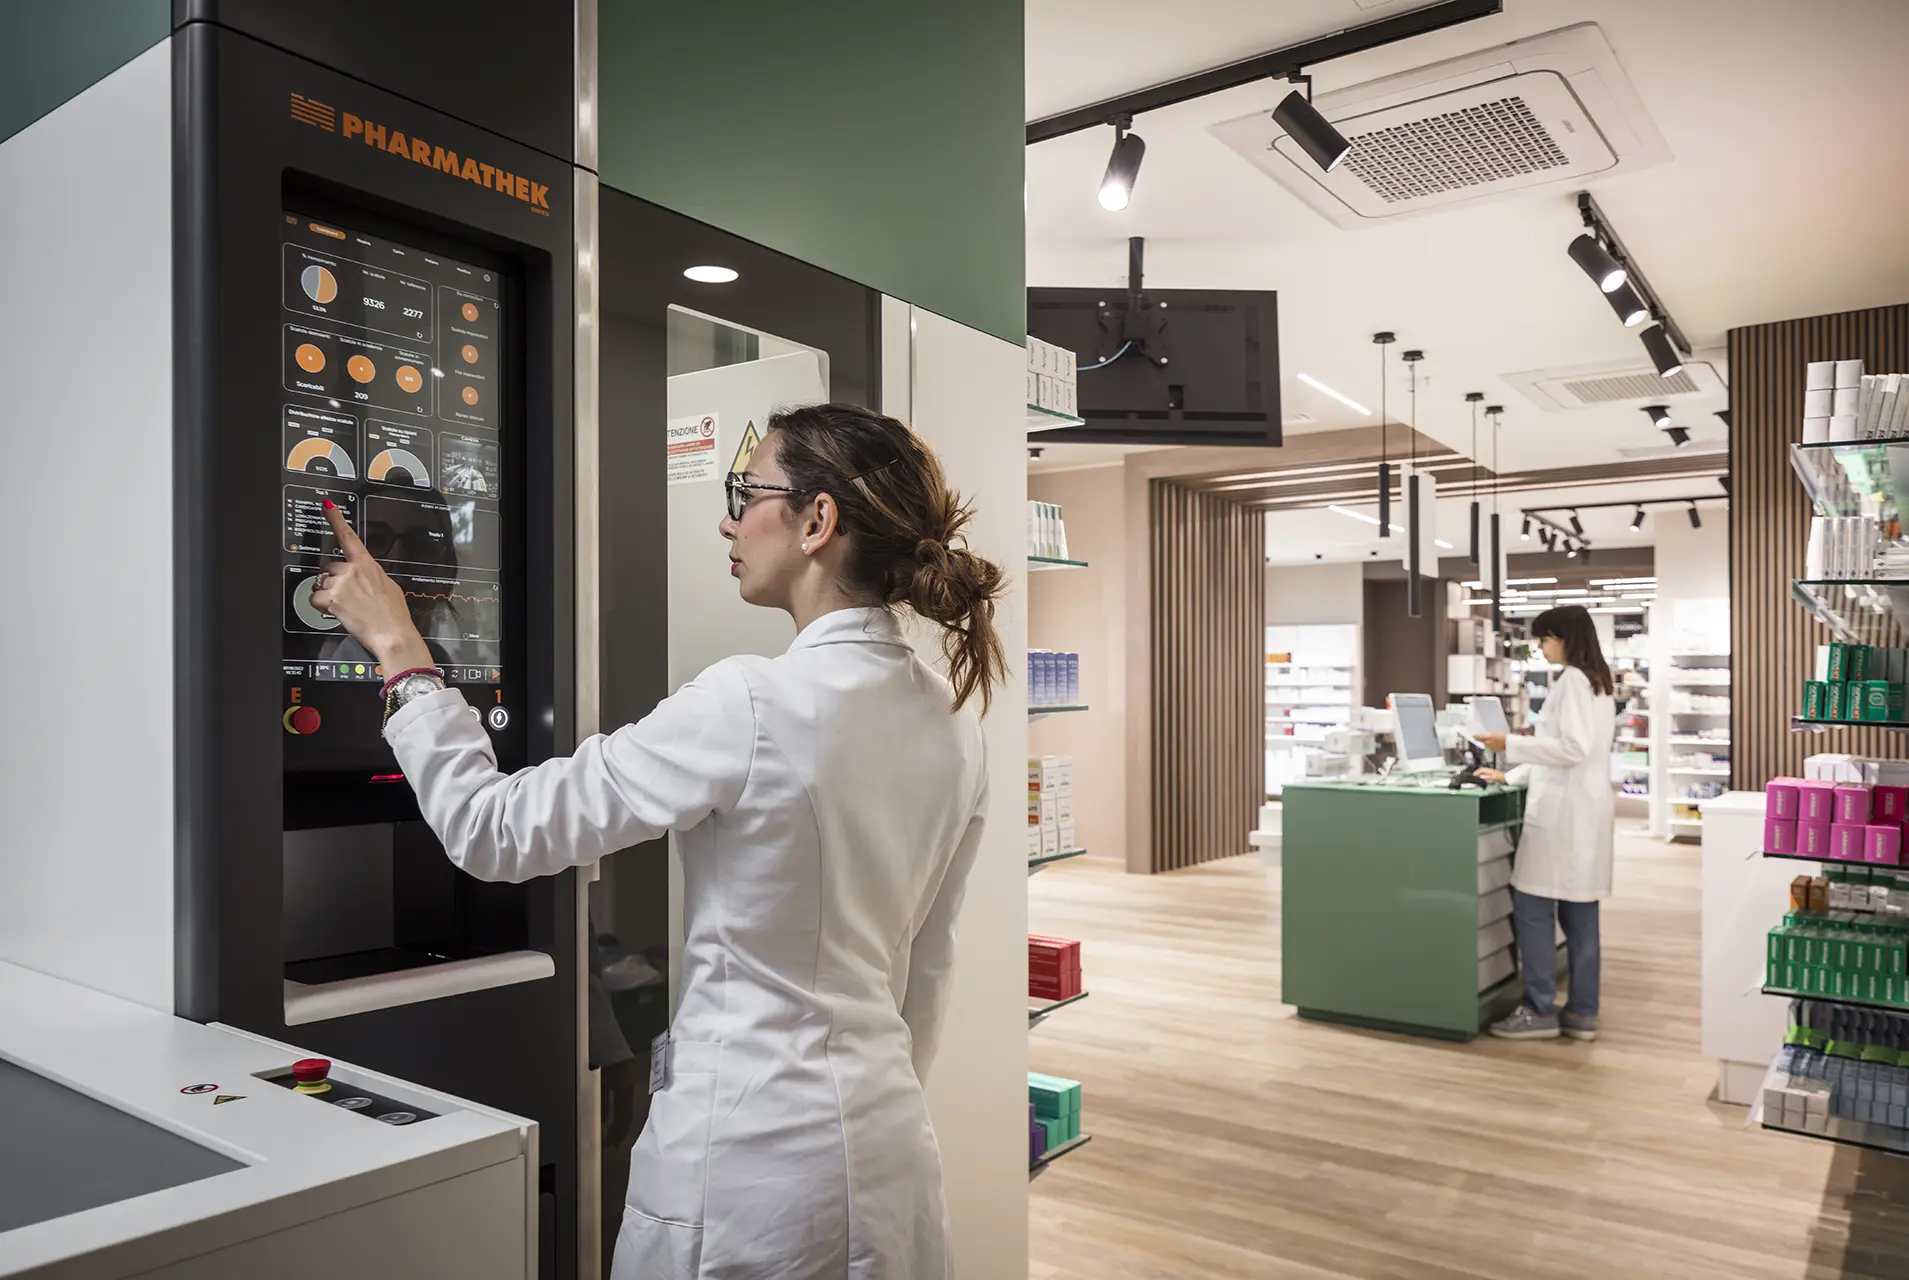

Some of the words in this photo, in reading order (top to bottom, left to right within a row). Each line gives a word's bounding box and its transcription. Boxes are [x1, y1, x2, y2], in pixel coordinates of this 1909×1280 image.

[342, 112, 550, 209] PHARMATHEK
[363, 297, 385, 310] 9326
[402, 307, 423, 319] 2277
[296, 381, 324, 391] Scaricabili
[354, 392, 368, 400] 209
[292, 688, 302, 703] E
[496, 689, 502, 703] 1
